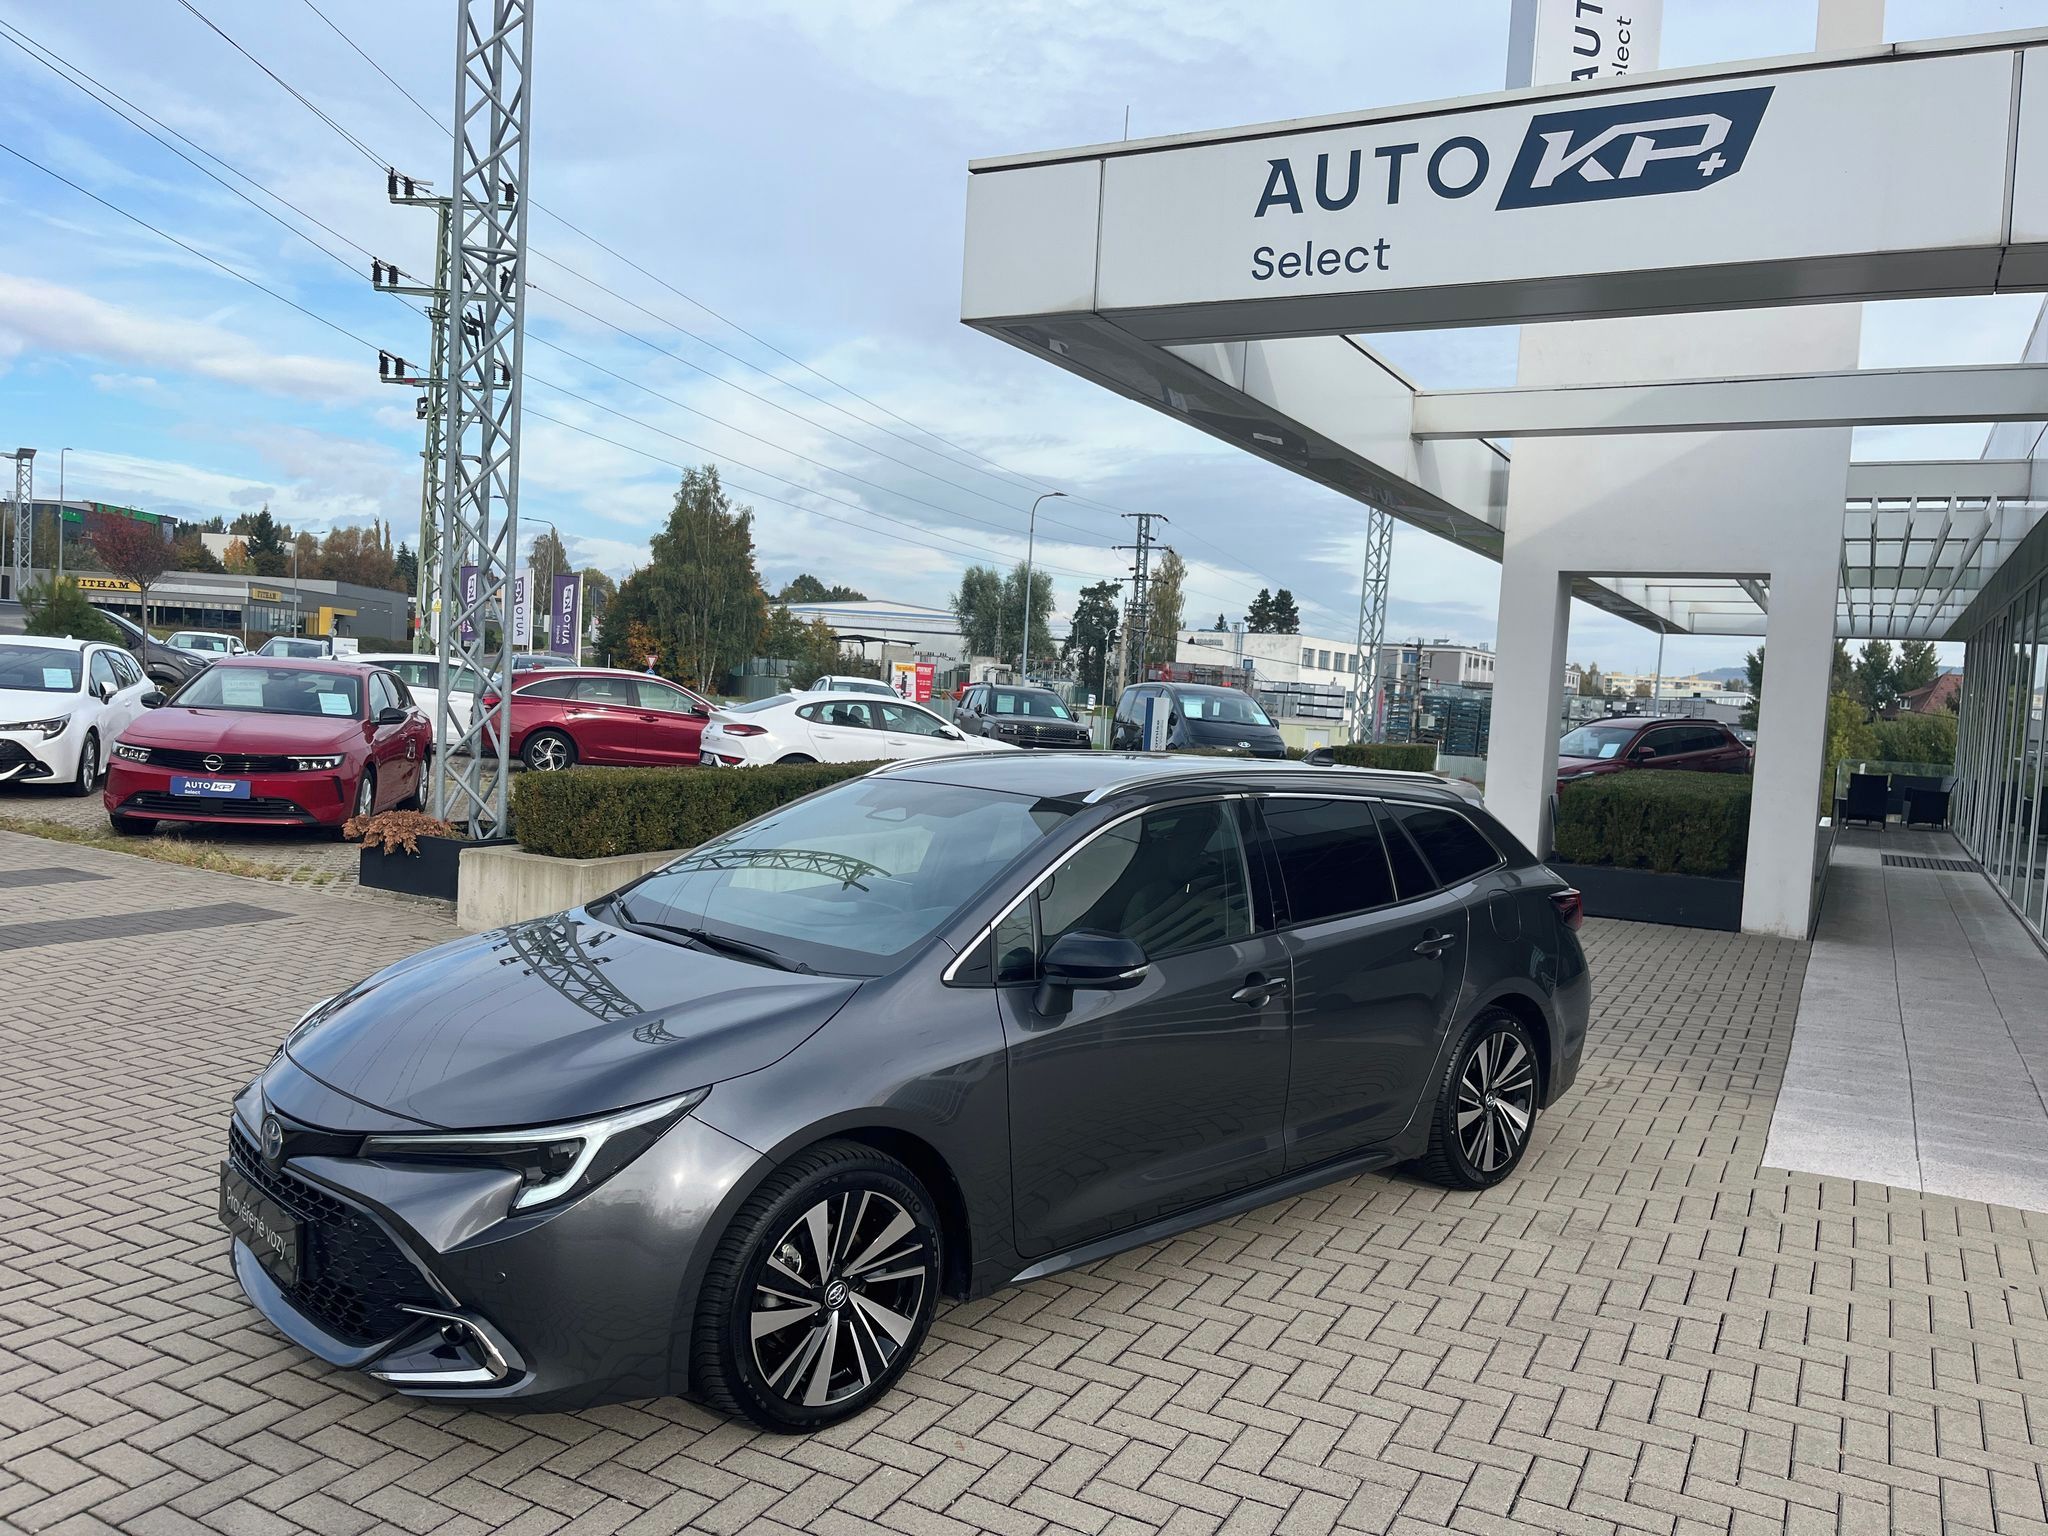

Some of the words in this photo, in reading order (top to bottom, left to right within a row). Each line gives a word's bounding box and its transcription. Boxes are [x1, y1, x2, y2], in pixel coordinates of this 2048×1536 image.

[1255, 135, 1490, 218] AUTO
[1252, 238, 1390, 281] Select
[78, 580, 130, 589] ITHAM
[184, 781, 211, 790] AUTO
[227, 1185, 265, 1238] Prověřené
[265, 1225, 287, 1260] vozy
